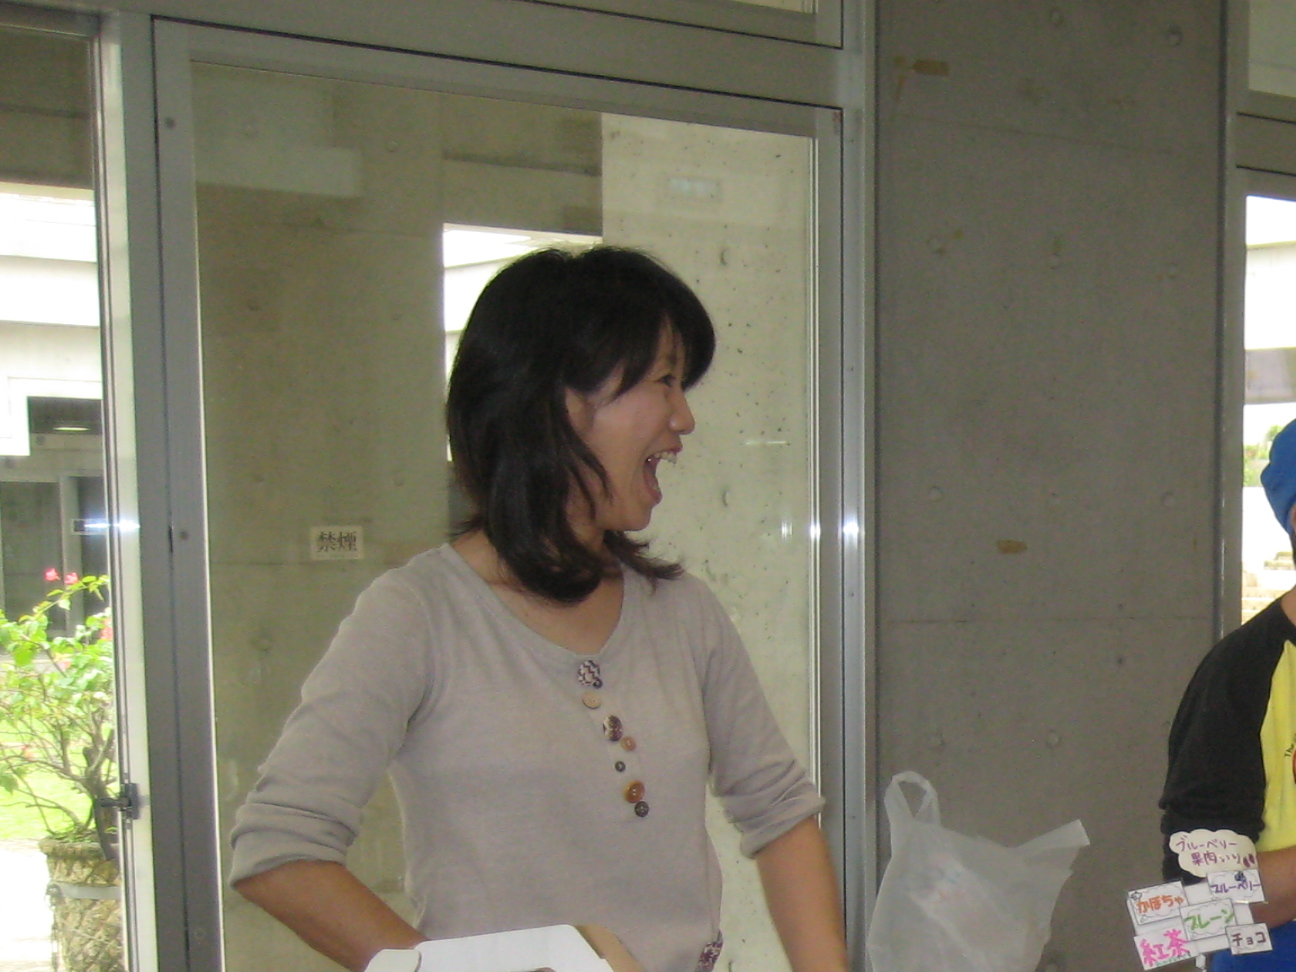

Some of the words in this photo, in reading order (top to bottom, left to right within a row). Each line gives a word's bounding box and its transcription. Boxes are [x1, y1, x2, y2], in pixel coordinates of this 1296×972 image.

[1175, 834, 1238, 852] ブルーベリー
[1135, 894, 1185, 914] かぼちゃ
[1183, 908, 1234, 931] プレーン
[1139, 928, 1191, 967] 紅茶
[1231, 931, 1267, 947] チョコ
